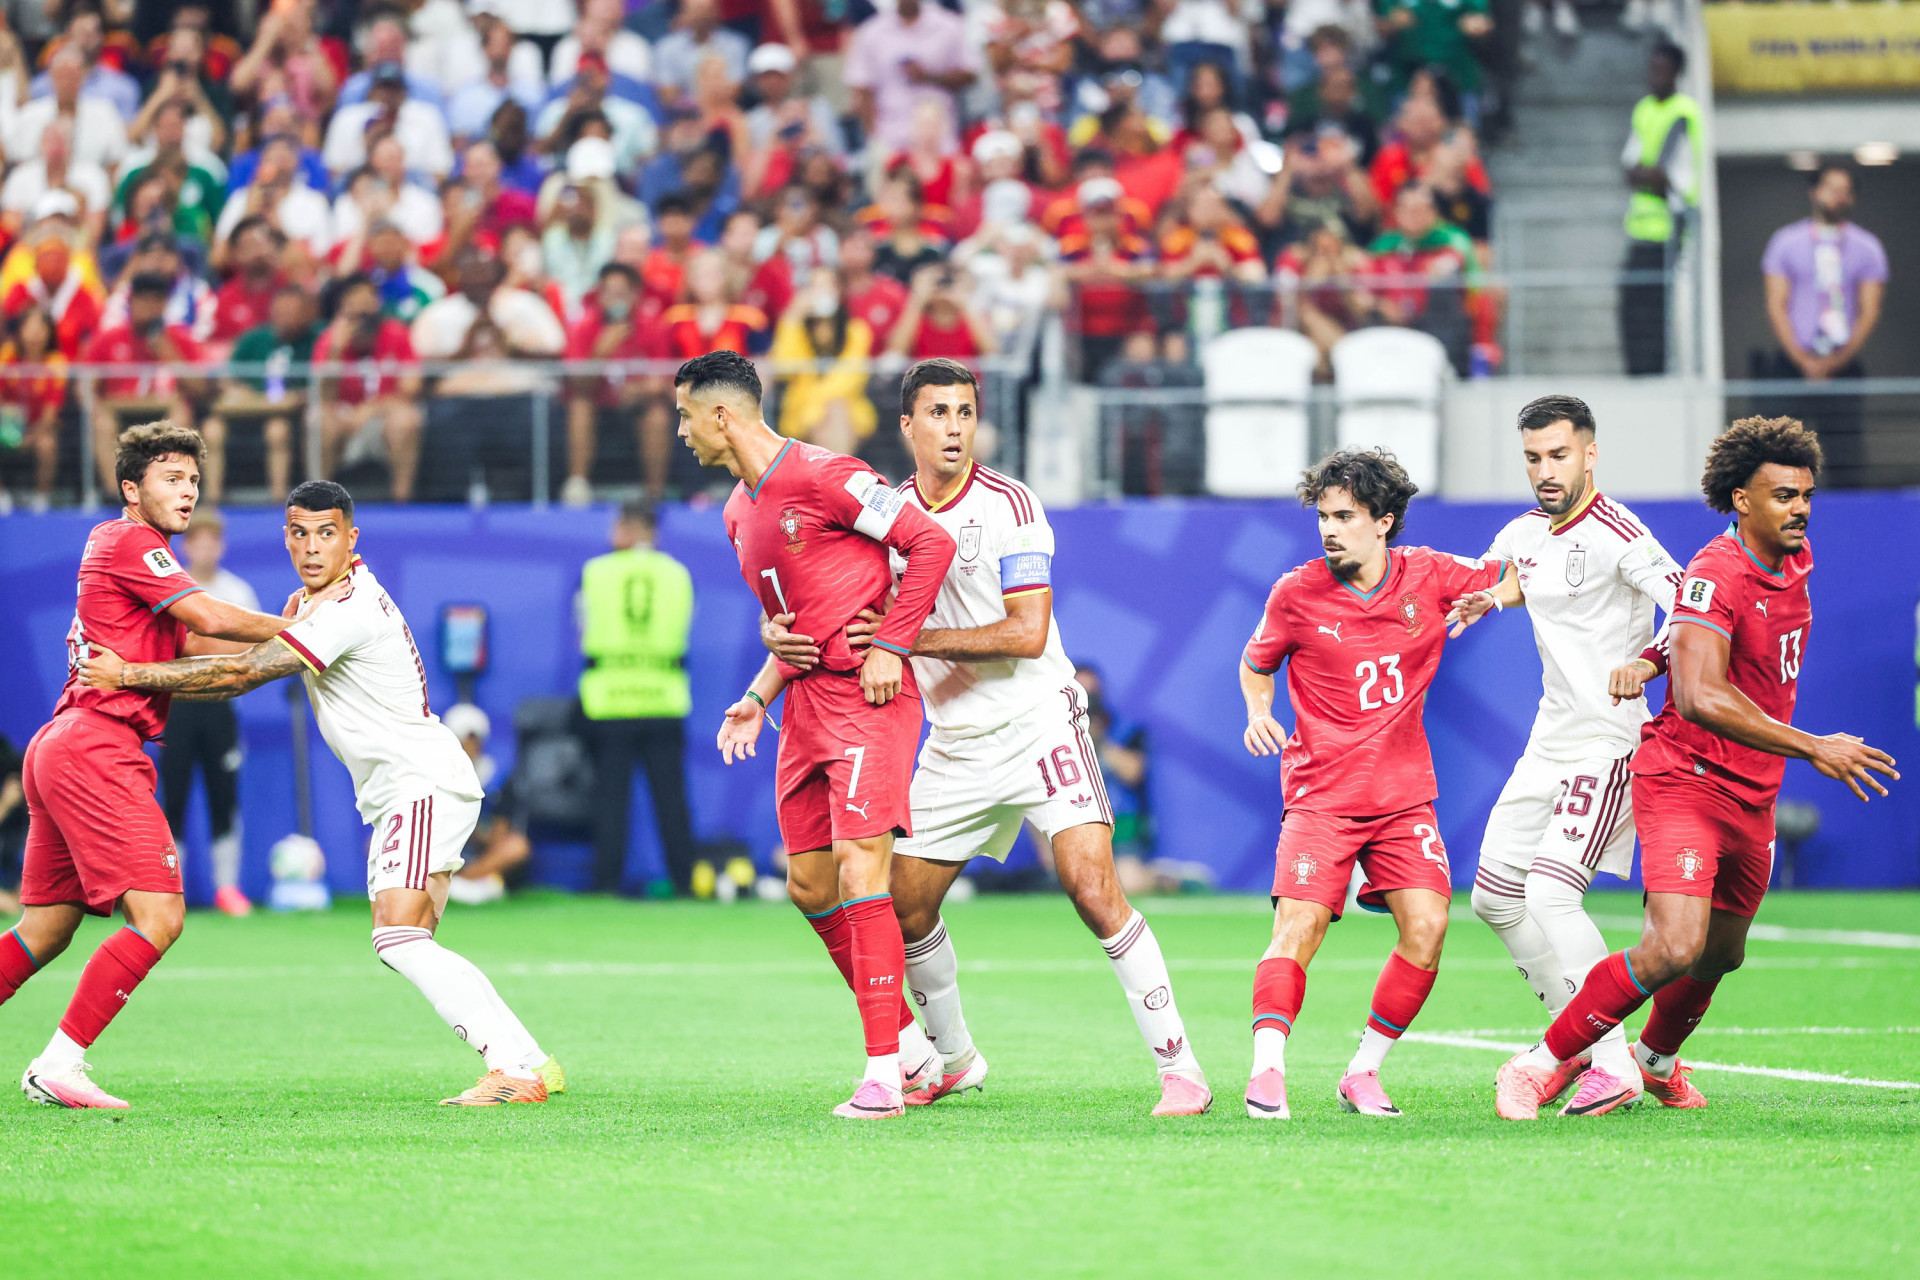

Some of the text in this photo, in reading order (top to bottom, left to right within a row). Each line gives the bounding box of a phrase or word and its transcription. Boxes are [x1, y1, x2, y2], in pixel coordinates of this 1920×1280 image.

[760, 566, 788, 615] 7
[1016, 561, 1047, 571] UNITES
[1355, 653, 1404, 711] 23
[1779, 627, 1802, 685] 13
[844, 745, 866, 799] 7
[1037, 745, 1082, 798] 16
[1554, 775, 1599, 816] 15
